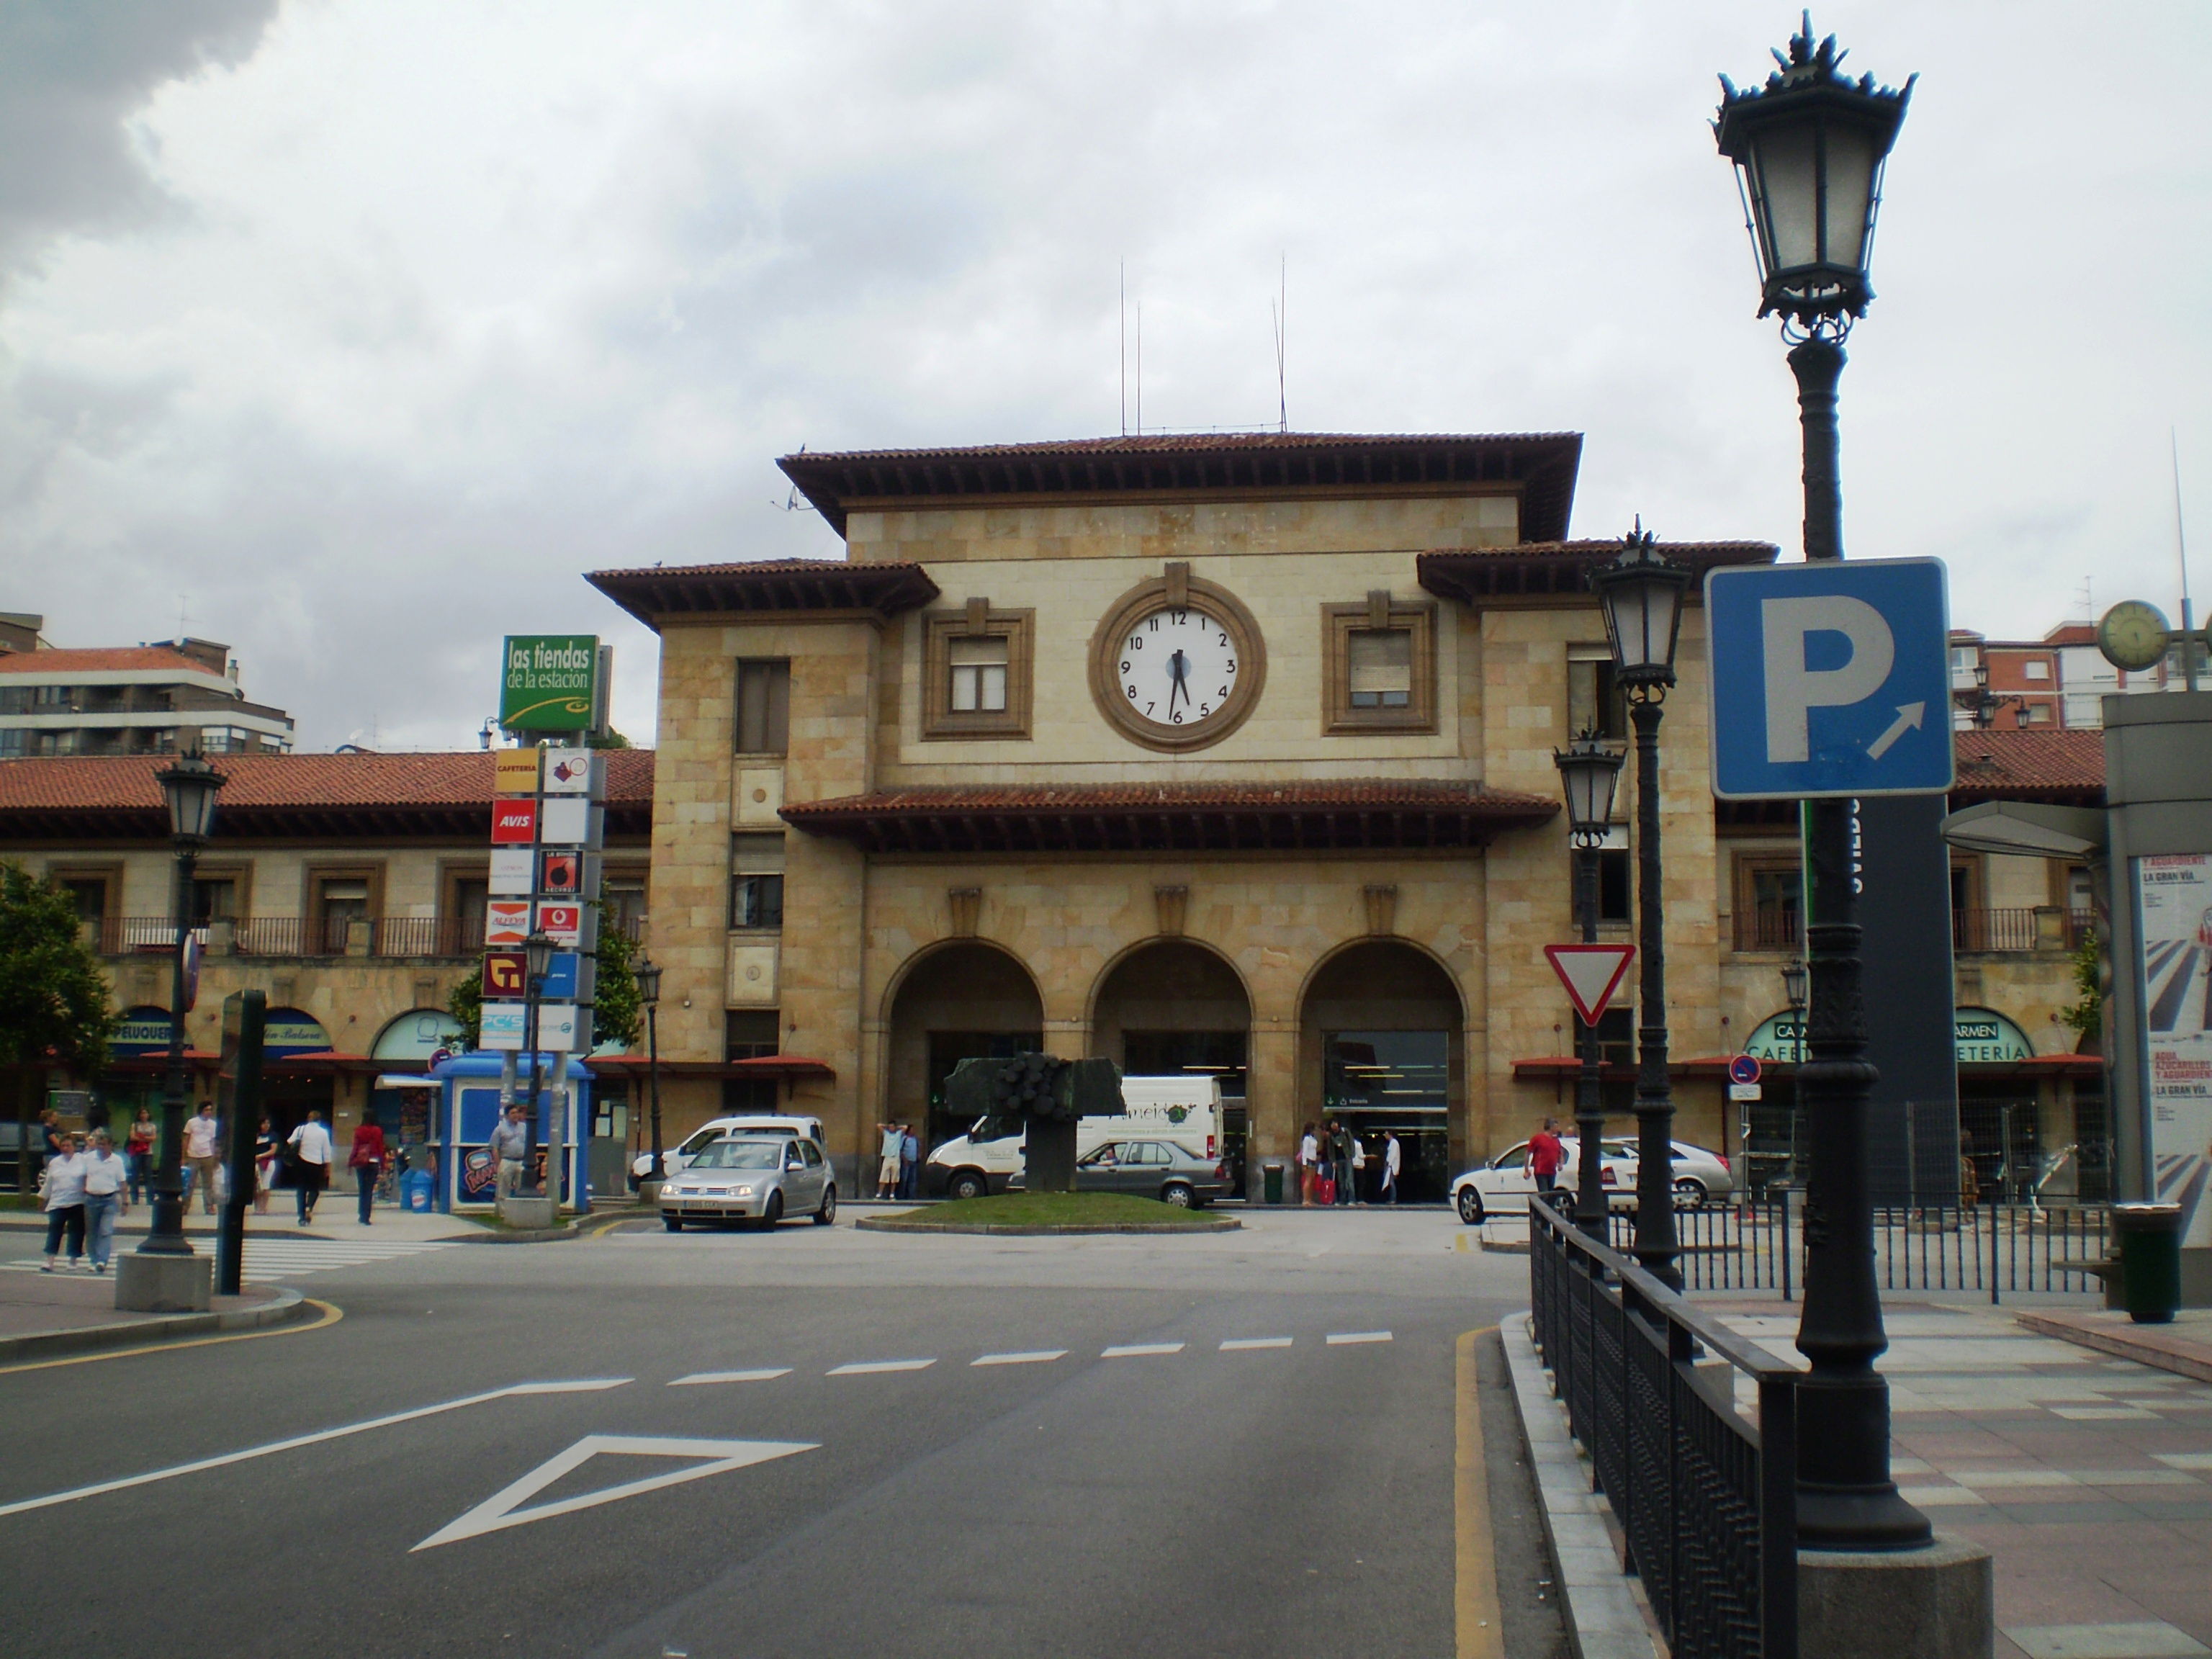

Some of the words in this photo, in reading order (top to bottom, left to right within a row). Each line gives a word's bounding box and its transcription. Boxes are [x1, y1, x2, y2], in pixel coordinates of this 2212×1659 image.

[1150, 619, 1159, 631] 11
[1172, 612, 1186, 625] 12
[1201, 618, 1205, 630] 1
[1130, 637, 1143, 650] 10
[1219, 634, 1227, 647] 2
[508, 641, 530, 669] las
[534, 641, 589, 669] tiendas
[1121, 661, 1130, 674] 9
[1226, 660, 1236, 673] 3
[507, 669, 523, 688] de
[525, 669, 536, 688] la
[539, 669, 588, 688] estación
[1761, 595, 1894, 763] P
[1128, 685, 1137, 698] 8
[1218, 685, 1228, 698] 4
[1146, 702, 1155, 716] 7
[1200, 703, 1210, 716] 5
[1173, 711, 1183, 724] 6
[499, 815, 530, 827] AVIS
[2144, 873, 2154, 882] LA
[2156, 872, 2178, 881] GRAN
[113, 1026, 171, 1040] PELUQUER
[1955, 1025, 1997, 1037] ARMEN
[1956, 1043, 2026, 1061] ETERÍA
[2163, 1070, 2212, 1079] AGUARDIEN
[2157, 1086, 2167, 1095] LA
[2168, 1086, 2191, 1095] GRAN
